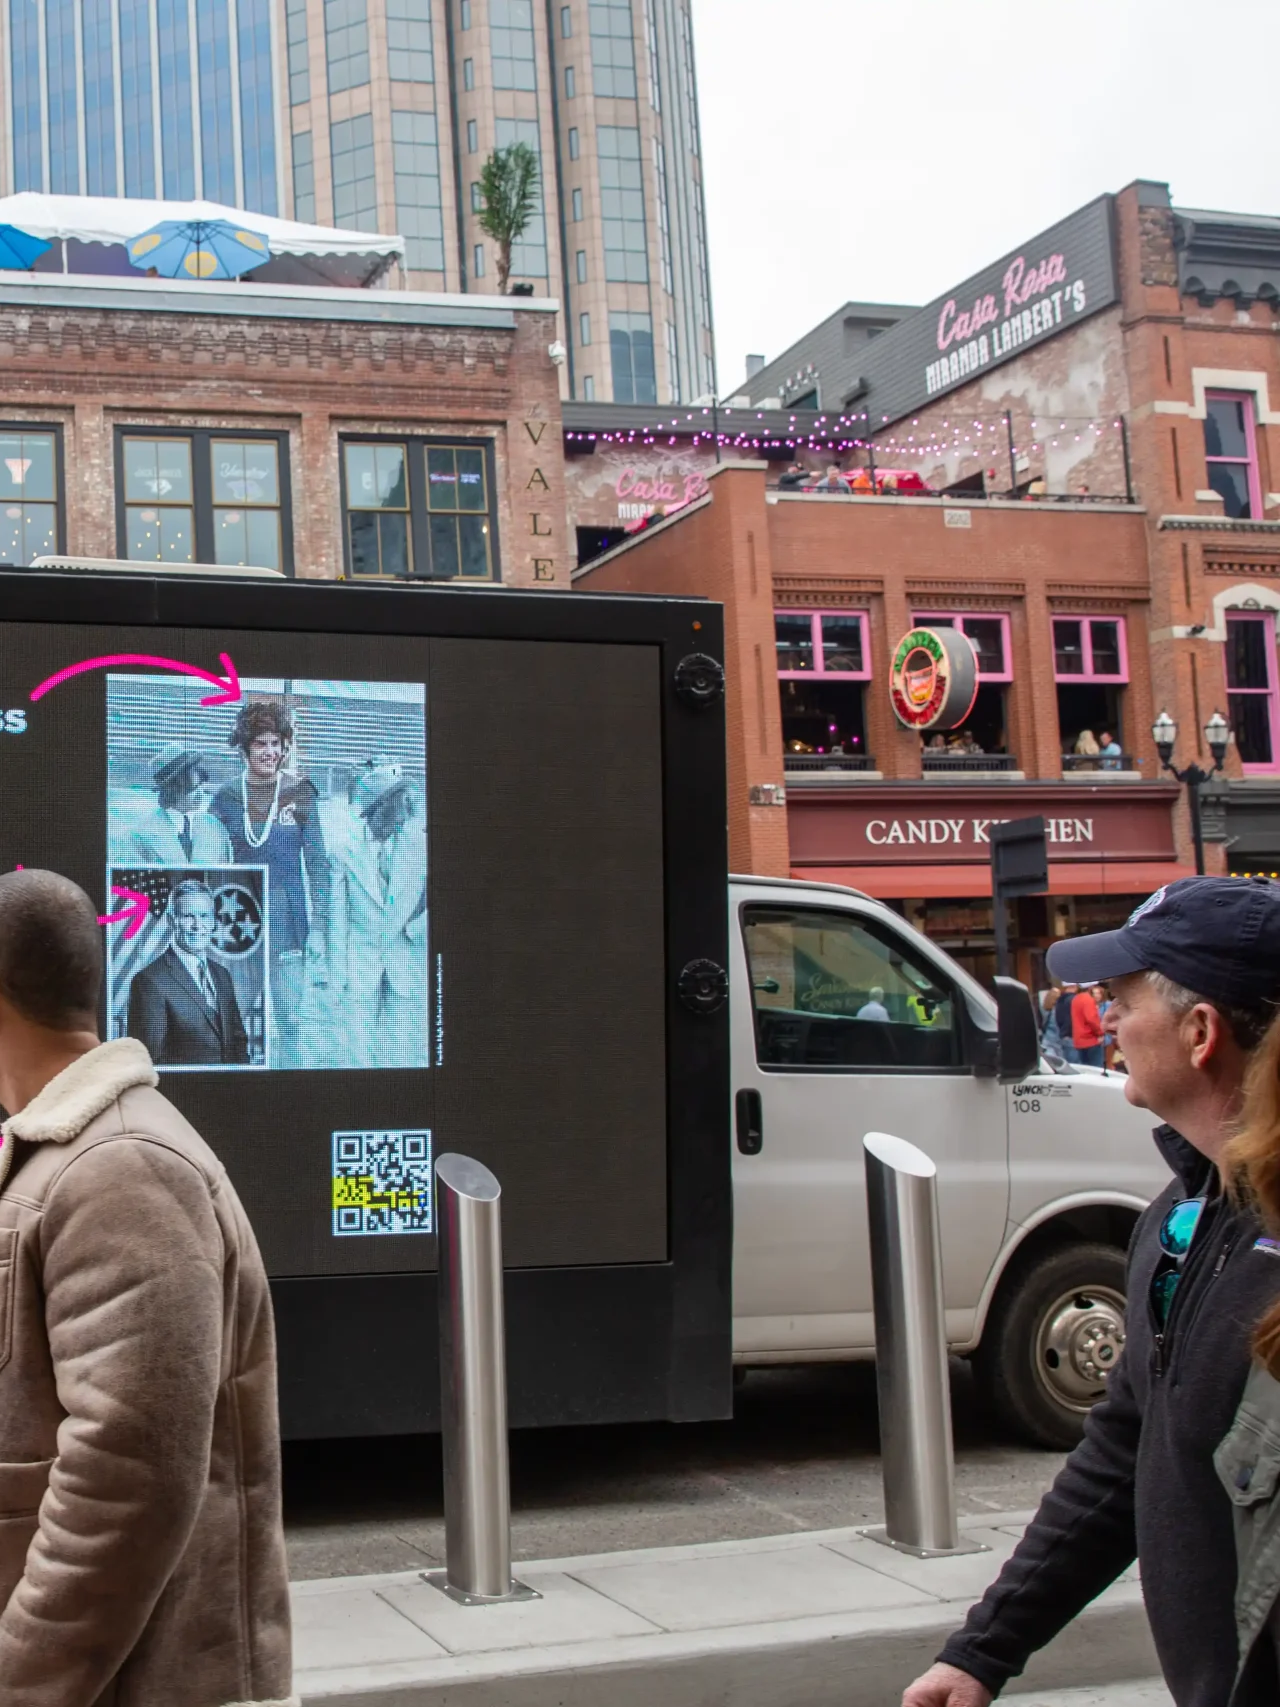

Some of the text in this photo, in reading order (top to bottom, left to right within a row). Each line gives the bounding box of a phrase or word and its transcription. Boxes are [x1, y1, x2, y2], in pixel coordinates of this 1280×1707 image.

[937, 256, 1067, 351] Casa Rosa
[926, 279, 1086, 395] MIRANDA LAMBERT'S
[524, 422, 555, 582] VALE
[616, 468, 678, 500] Casa
[865, 819, 965, 845] CANDY
[1013, 1099, 1041, 1113] 108
